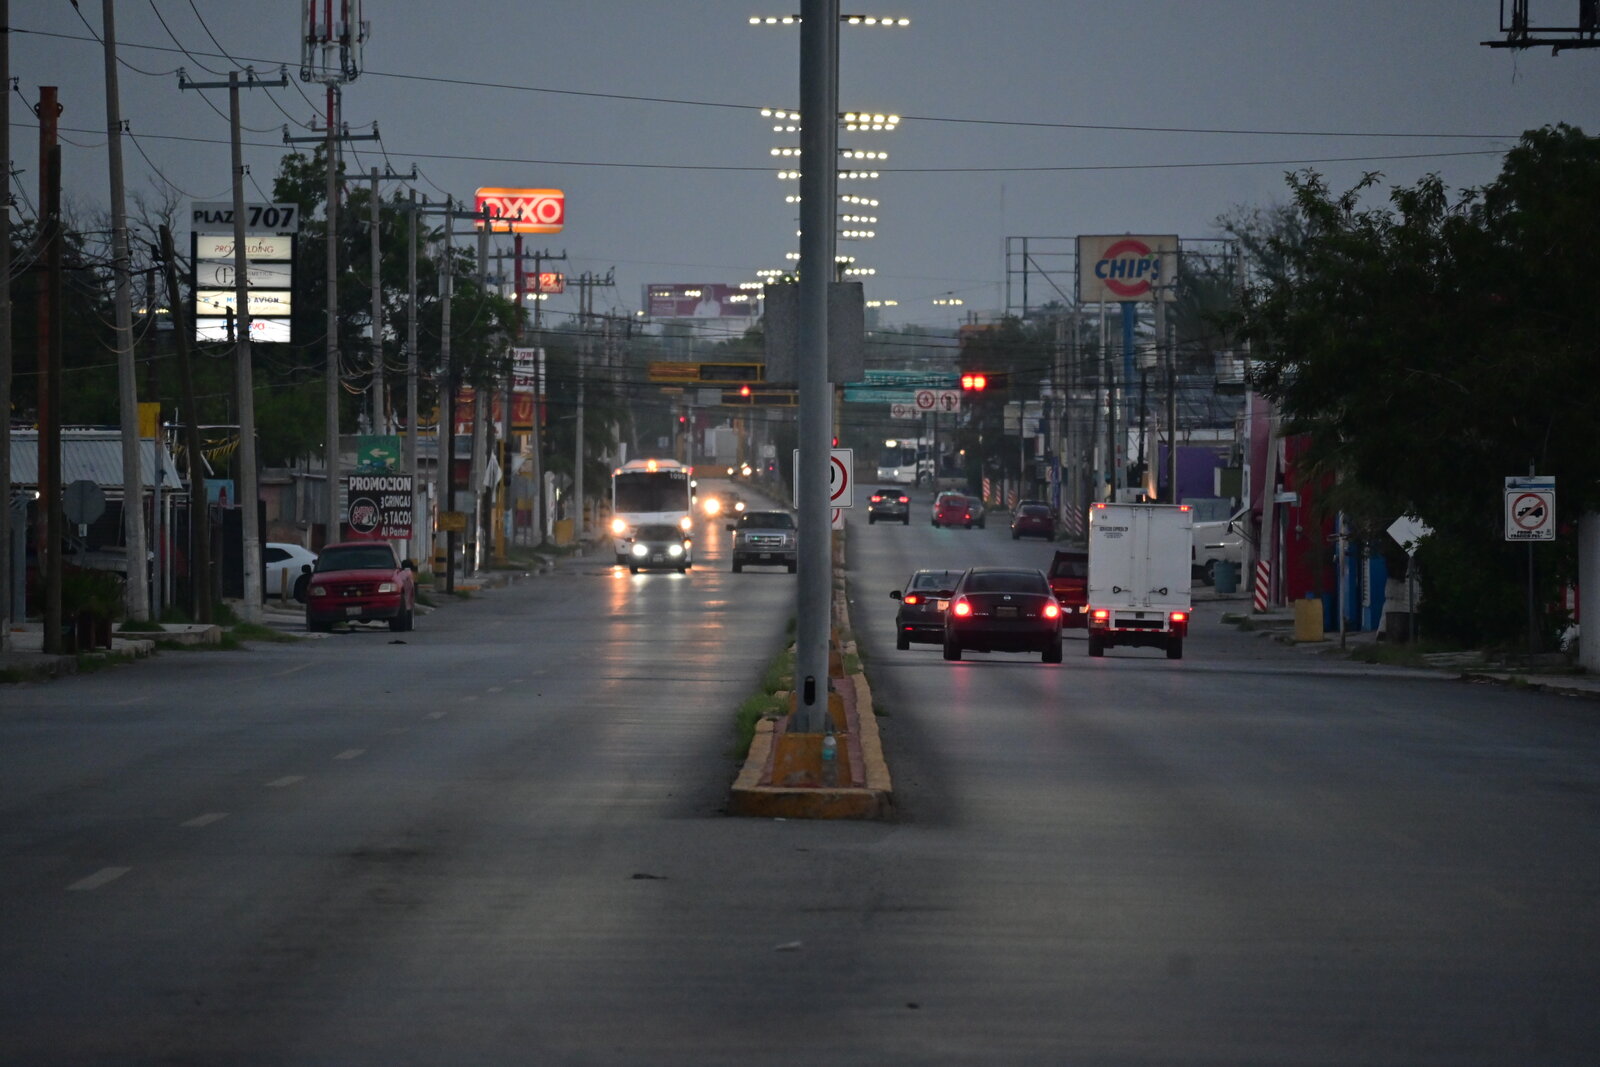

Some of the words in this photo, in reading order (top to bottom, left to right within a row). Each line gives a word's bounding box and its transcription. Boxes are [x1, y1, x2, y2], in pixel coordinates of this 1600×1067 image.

[480, 197, 561, 223] OXXO
[193, 210, 235, 224] PLAZ
[248, 207, 294, 228] 707
[349, 477, 411, 491] PROMOCION
[384, 496, 411, 508] GRINGAS
[384, 512, 388, 524] 5
[390, 511, 412, 524] TACOS
[389, 527, 409, 536] Pastor
